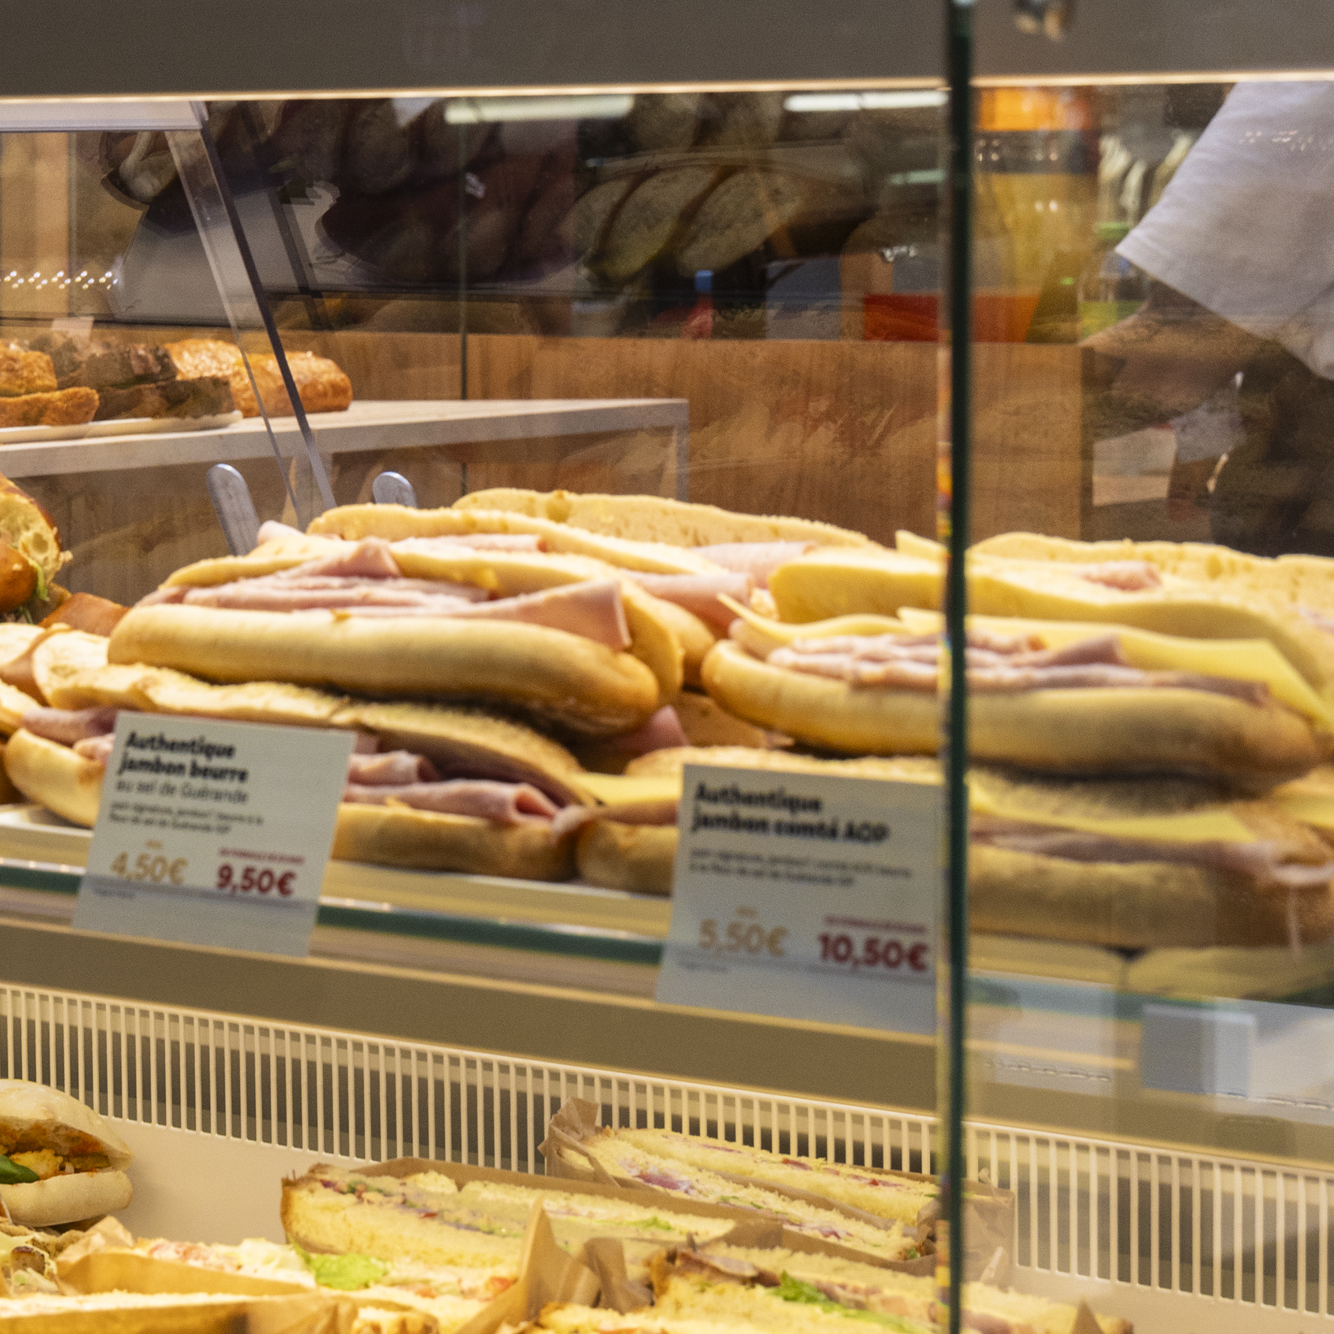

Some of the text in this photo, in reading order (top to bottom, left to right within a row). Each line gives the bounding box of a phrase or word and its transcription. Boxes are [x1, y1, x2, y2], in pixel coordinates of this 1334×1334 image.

[125, 731, 235, 759] Authentique
[116, 751, 248, 783] jambon beurre
[694, 783, 822, 814] Authentique
[691, 808, 769, 834] jambon
[843, 821, 889, 844] AOP
[108, 851, 187, 888] 4,50€
[215, 864, 295, 902] 9,50€
[699, 918, 787, 959] 5,50€
[819, 933, 928, 972] 10,50€
